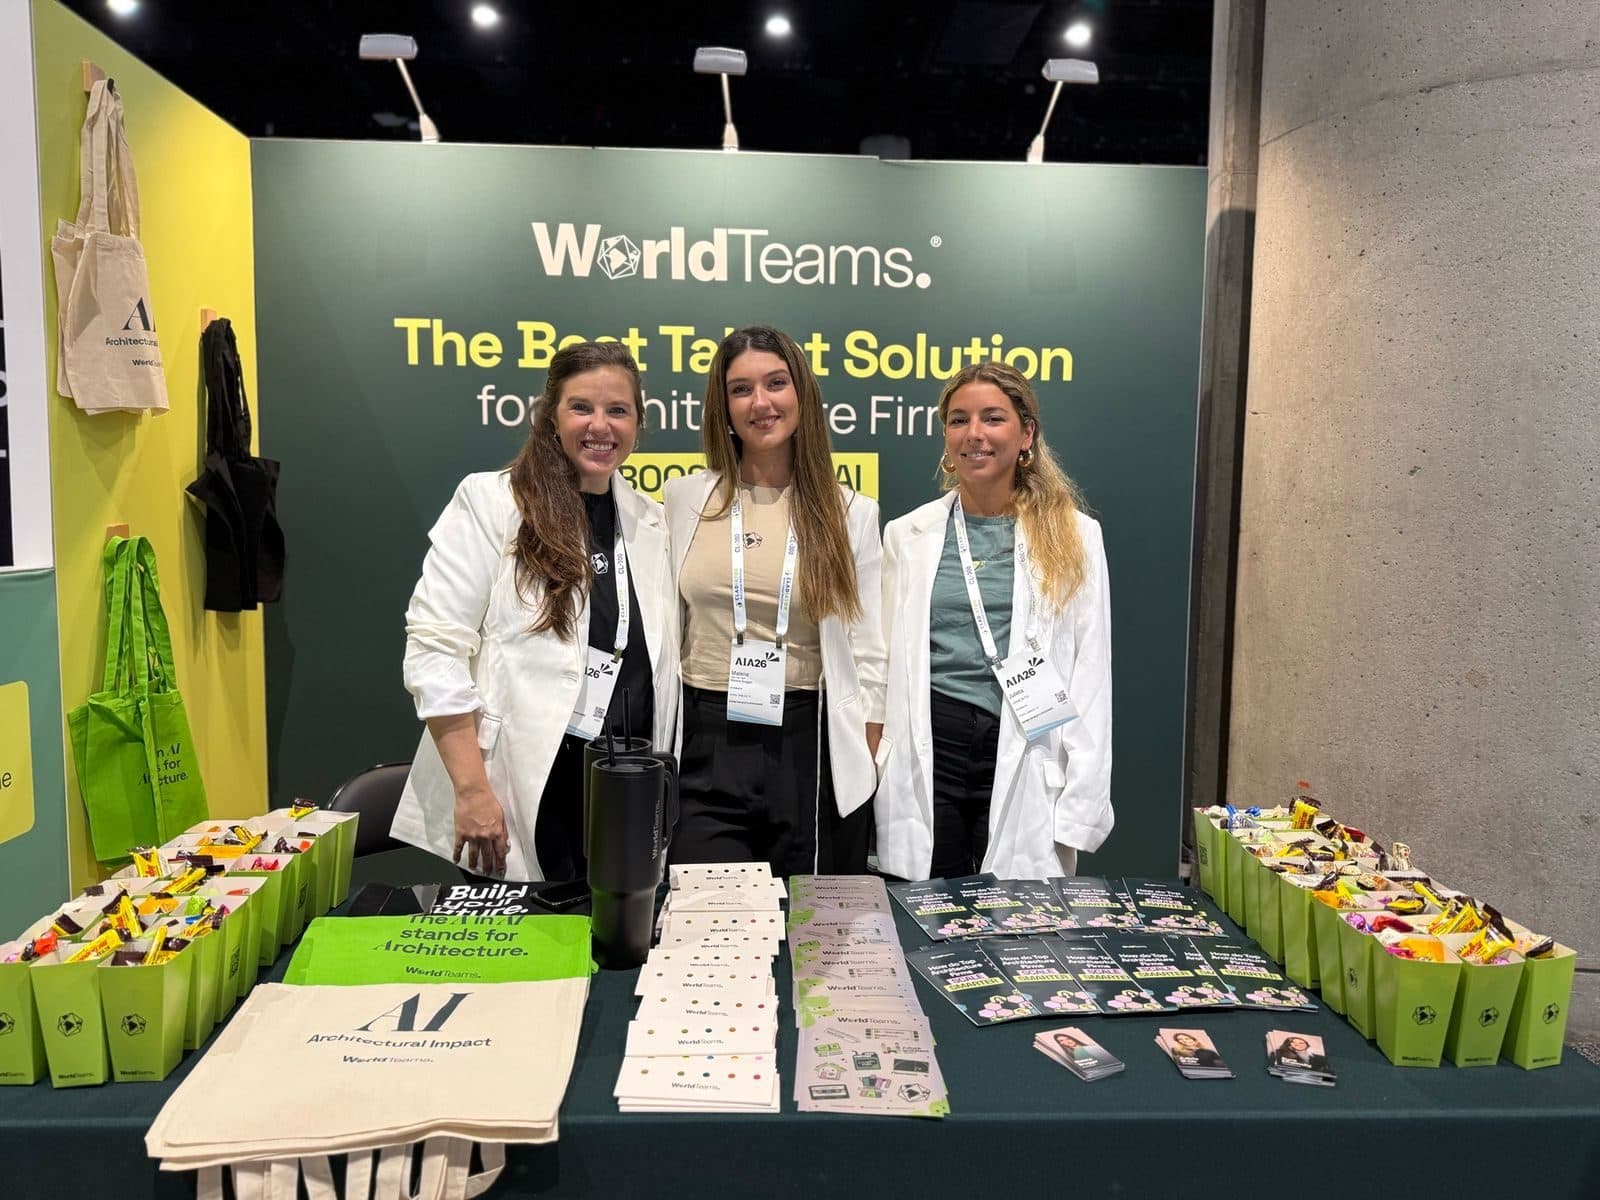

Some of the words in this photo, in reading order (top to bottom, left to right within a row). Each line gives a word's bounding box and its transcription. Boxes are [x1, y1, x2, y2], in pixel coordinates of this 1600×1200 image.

[121, 297, 156, 332] A
[394, 317, 503, 368] The
[516, 320, 648, 371] Bt
[659, 325, 830, 376] Tat
[843, 330, 1074, 382] Solution
[477, 384, 534, 426] fo
[836, 464, 861, 492] AI
[584, 665, 601, 680] 26
[164, 760, 181, 770] for
[445, 884, 529, 900] Build
[433, 905, 529, 916] uture.
[442, 898, 519, 910] your
[400, 928, 478, 941] stands
[485, 929, 518, 941] for
[374, 940, 528, 957] Architecture.
[353, 992, 475, 1032] AI
[307, 1034, 426, 1049] Architectural
[430, 1038, 492, 1050] Impact
